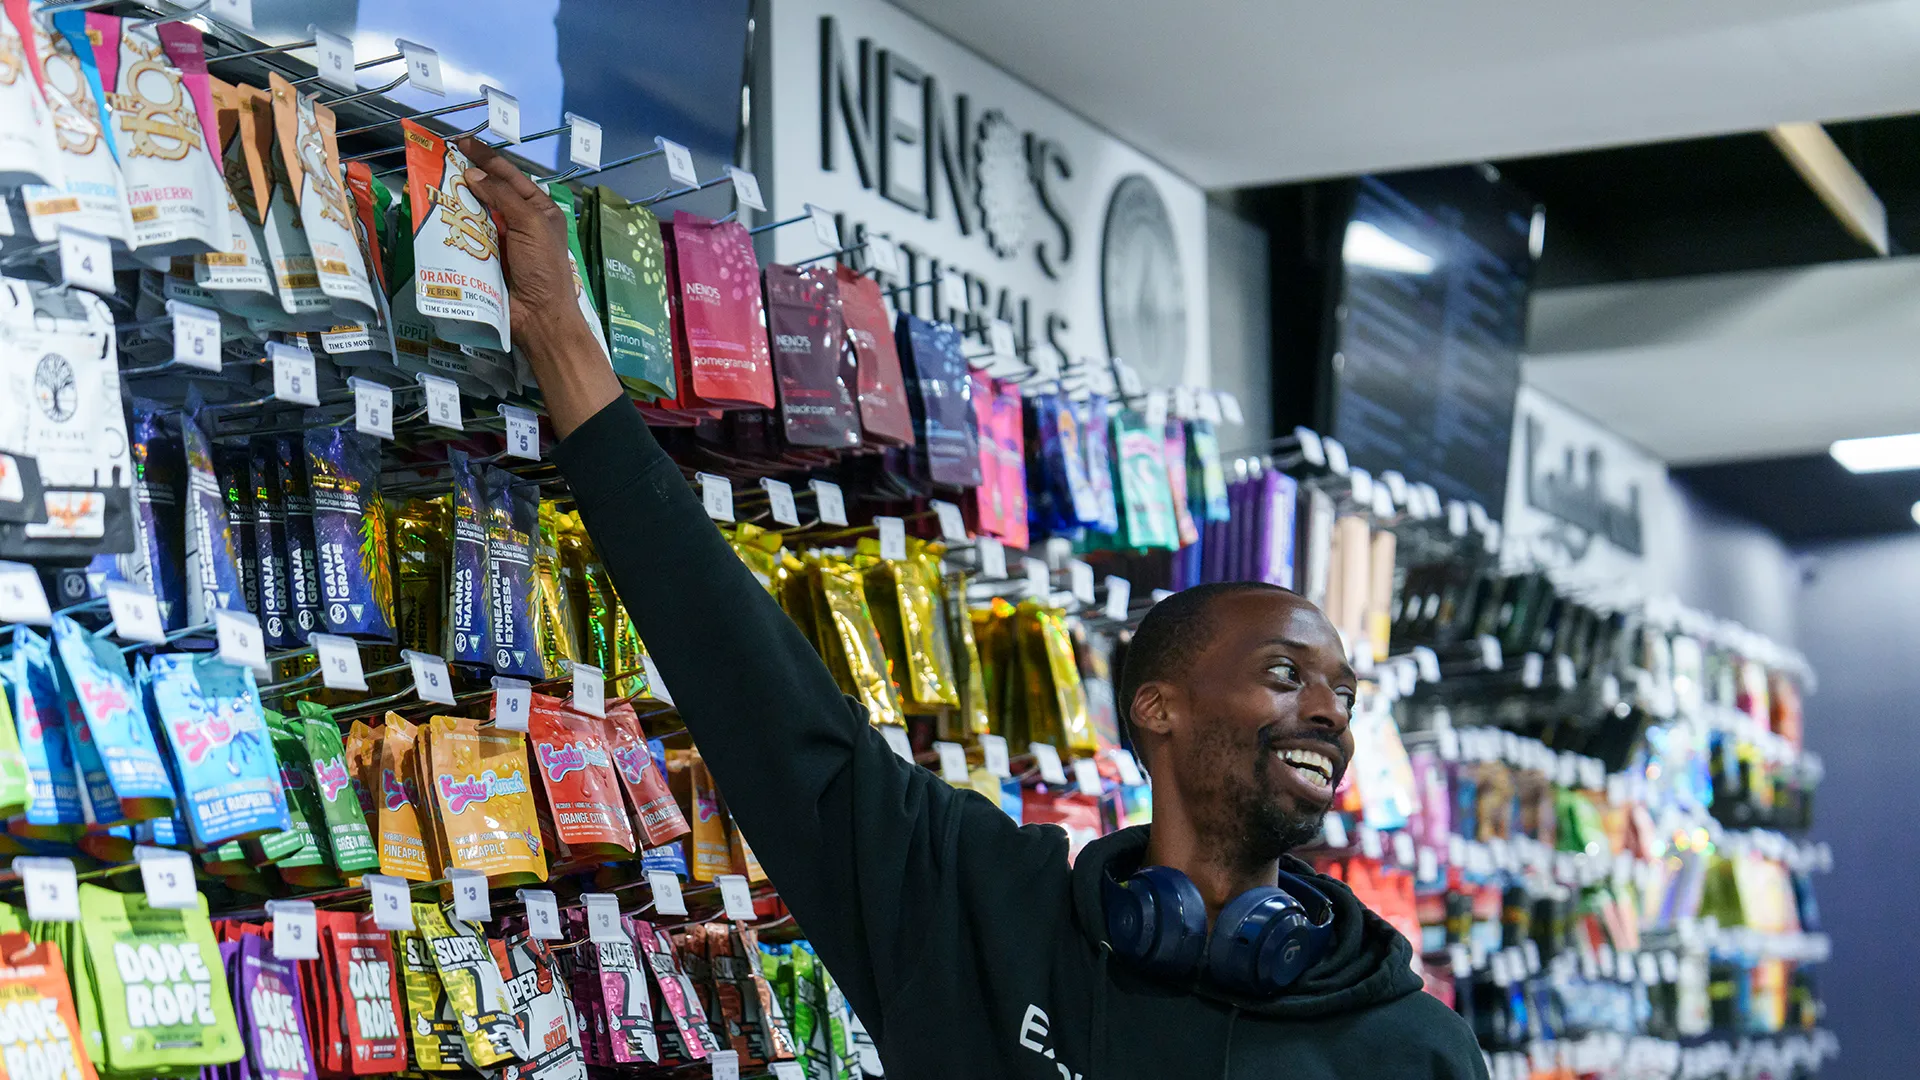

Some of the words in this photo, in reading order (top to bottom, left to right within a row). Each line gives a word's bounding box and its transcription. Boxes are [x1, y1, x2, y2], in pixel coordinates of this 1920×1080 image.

[820, 15, 1073, 281] NENO'S
[236, 276, 263, 284] MONEY
[420, 269, 469, 288] ORANGE
[436, 286, 459, 298] RESIN
[464, 291, 479, 302] THC
[424, 304, 441, 313] TIME
[451, 307, 475, 317] MONEY
[328, 342, 345, 350] TIME
[345, 341, 352, 349] IS
[353, 339, 374, 348] MONEY
[612, 329, 641, 347] lemon
[430, 356, 443, 367] TIME
[365, 403, 379, 426] $5
[436, 396, 449, 420] $5
[515, 430, 529, 452] $5
[291, 547, 306, 603] GANJA
[321, 542, 338, 598] GANJA
[332, 543, 350, 598] GRAPE
[265, 555, 275, 610] GANJA
[455, 569, 465, 627] CANNA
[464, 568, 473, 628] MANGO
[491, 560, 505, 646] PINEAPPLE
[503, 576, 514, 644] EXPRESS
[332, 656, 348, 674] $8
[424, 671, 439, 687] $8
[582, 682, 594, 699] $8
[506, 697, 519, 713] $8
[538, 743, 587, 783] Kushy
[438, 773, 489, 815] Kushy
[481, 770, 527, 796] Punch
[559, 812, 589, 825] ORANGE
[384, 844, 426, 861] PINEAPPLE
[457, 842, 506, 861] PINEAPPLE
[384, 893, 399, 910] $3
[464, 886, 477, 901] $3
[537, 909, 549, 925] $3
[598, 913, 610, 928] $3
[287, 923, 302, 941] $3
[434, 936, 485, 965] SUPER
[113, 941, 211, 984] DOPE
[348, 960, 391, 1000] DOPE
[125, 982, 217, 1029] ROPE
[251, 987, 299, 1034] DOPE
[356, 999, 400, 1040] ROPE
[543, 1024, 569, 1053] SOUR
